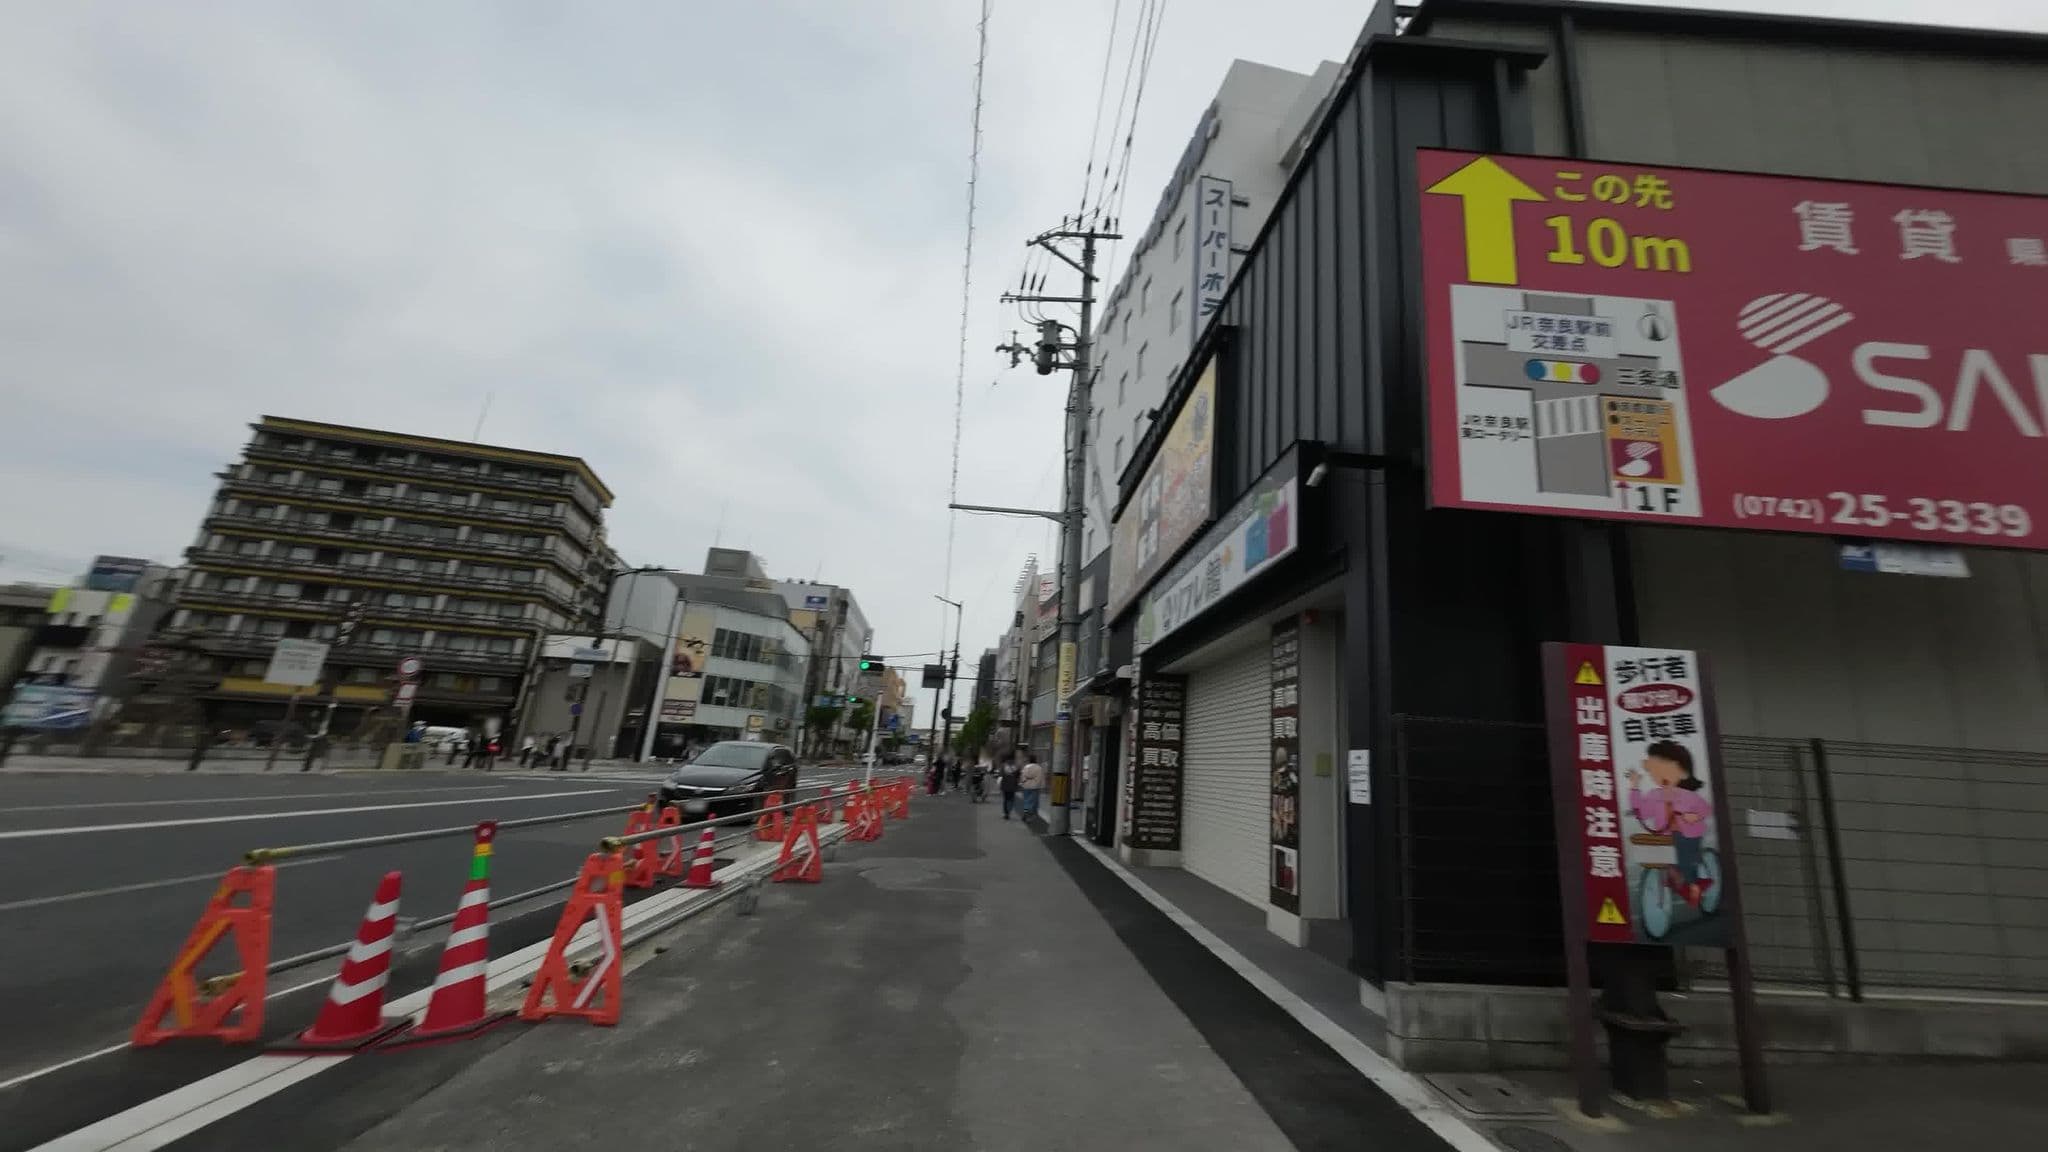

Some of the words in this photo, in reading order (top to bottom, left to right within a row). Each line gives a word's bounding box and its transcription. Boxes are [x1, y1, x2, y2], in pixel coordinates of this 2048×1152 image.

[1554, 171, 1673, 209] この先
[1545, 215, 1692, 272] 10m
[1507, 315, 1612, 338] JR奈良駅前
[1531, 334, 1588, 352] 交差点
[1617, 367, 1680, 390] 三条通
[1636, 485, 1679, 513] 1F
[1733, 493, 1824, 524] (0742)
[1827, 492, 2031, 537] 25-3339
[1615, 656, 1687, 684] 歩行者
[1143, 721, 1181, 740] 高価
[1622, 714, 1697, 742] 自転車
[1141, 747, 1179, 767] 買取
[1575, 696, 1622, 878] 出庫時注意
